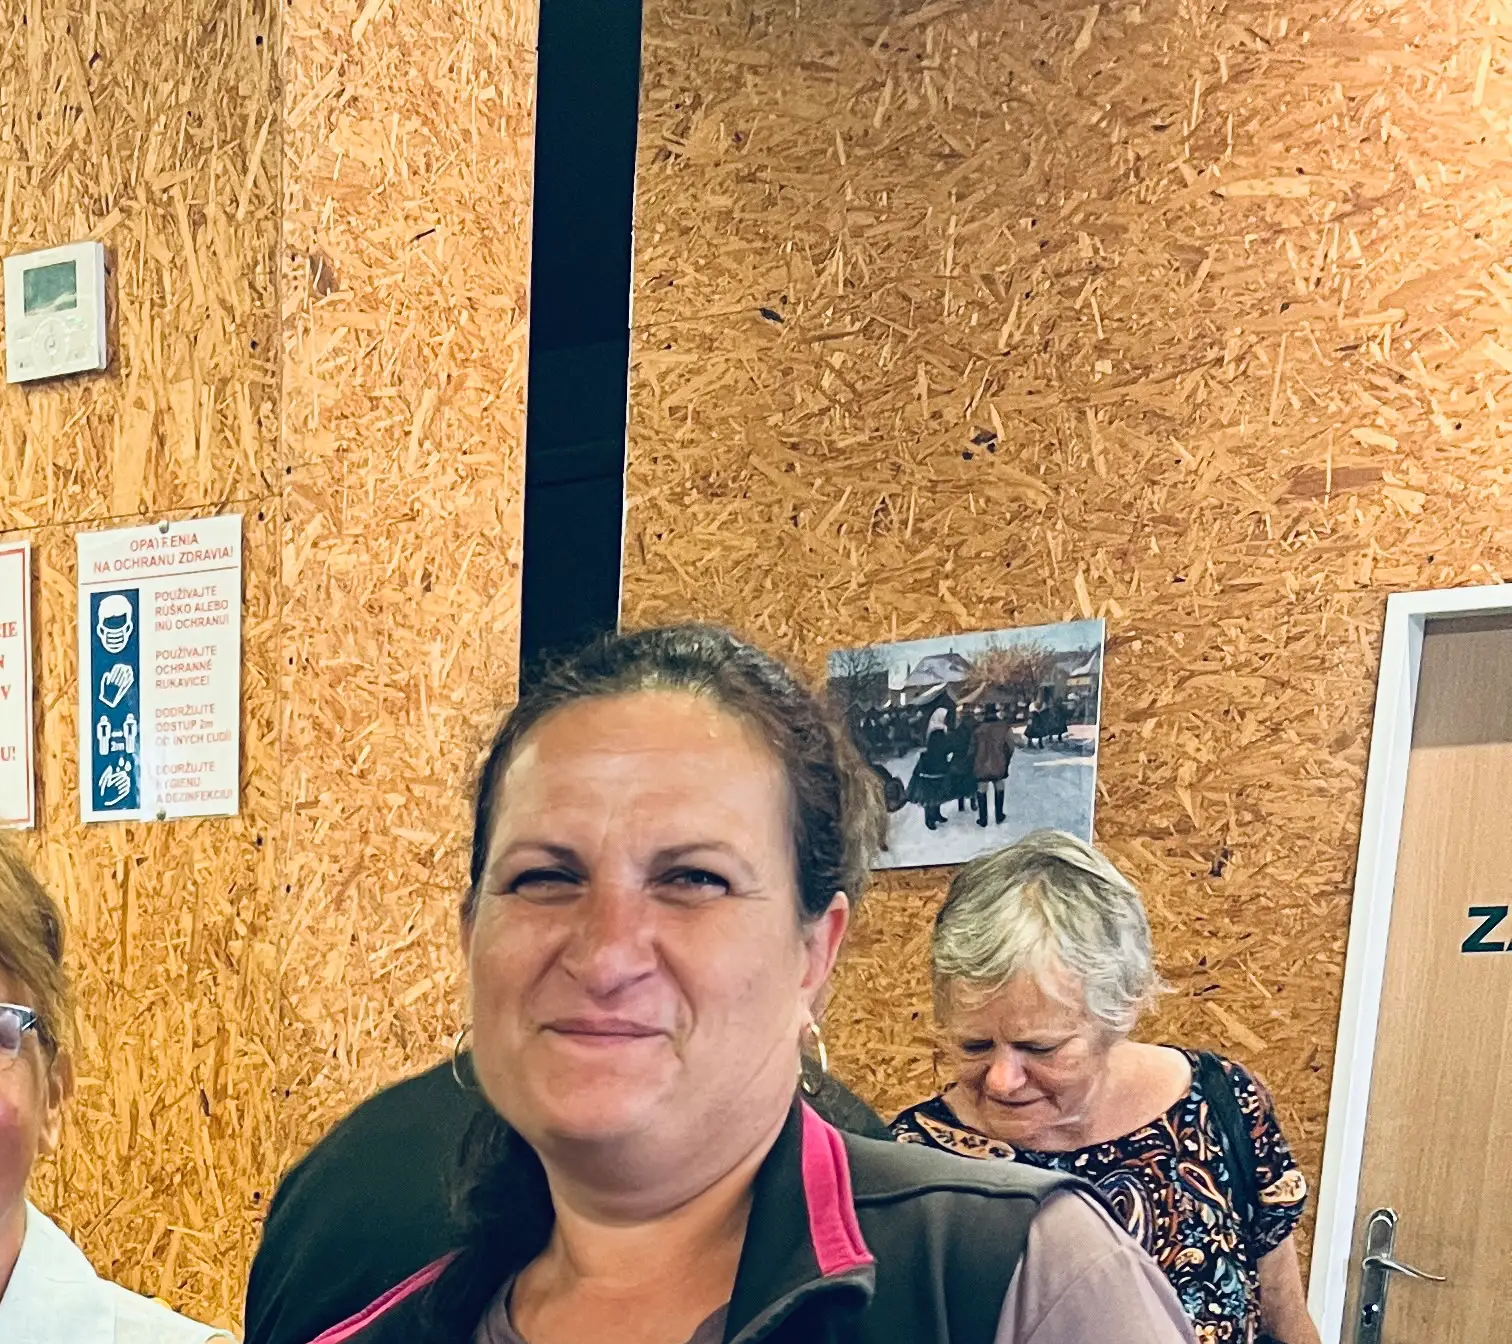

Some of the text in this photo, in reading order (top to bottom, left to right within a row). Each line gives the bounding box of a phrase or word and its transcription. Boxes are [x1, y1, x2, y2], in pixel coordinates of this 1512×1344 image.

[94, 561, 110, 573] NA
[114, 554, 175, 571] OCHRANU
[194, 600, 228, 612] ALEBO
[156, 659, 212, 675] OCHRANNÉ
[1461, 906, 1512, 953] Z
